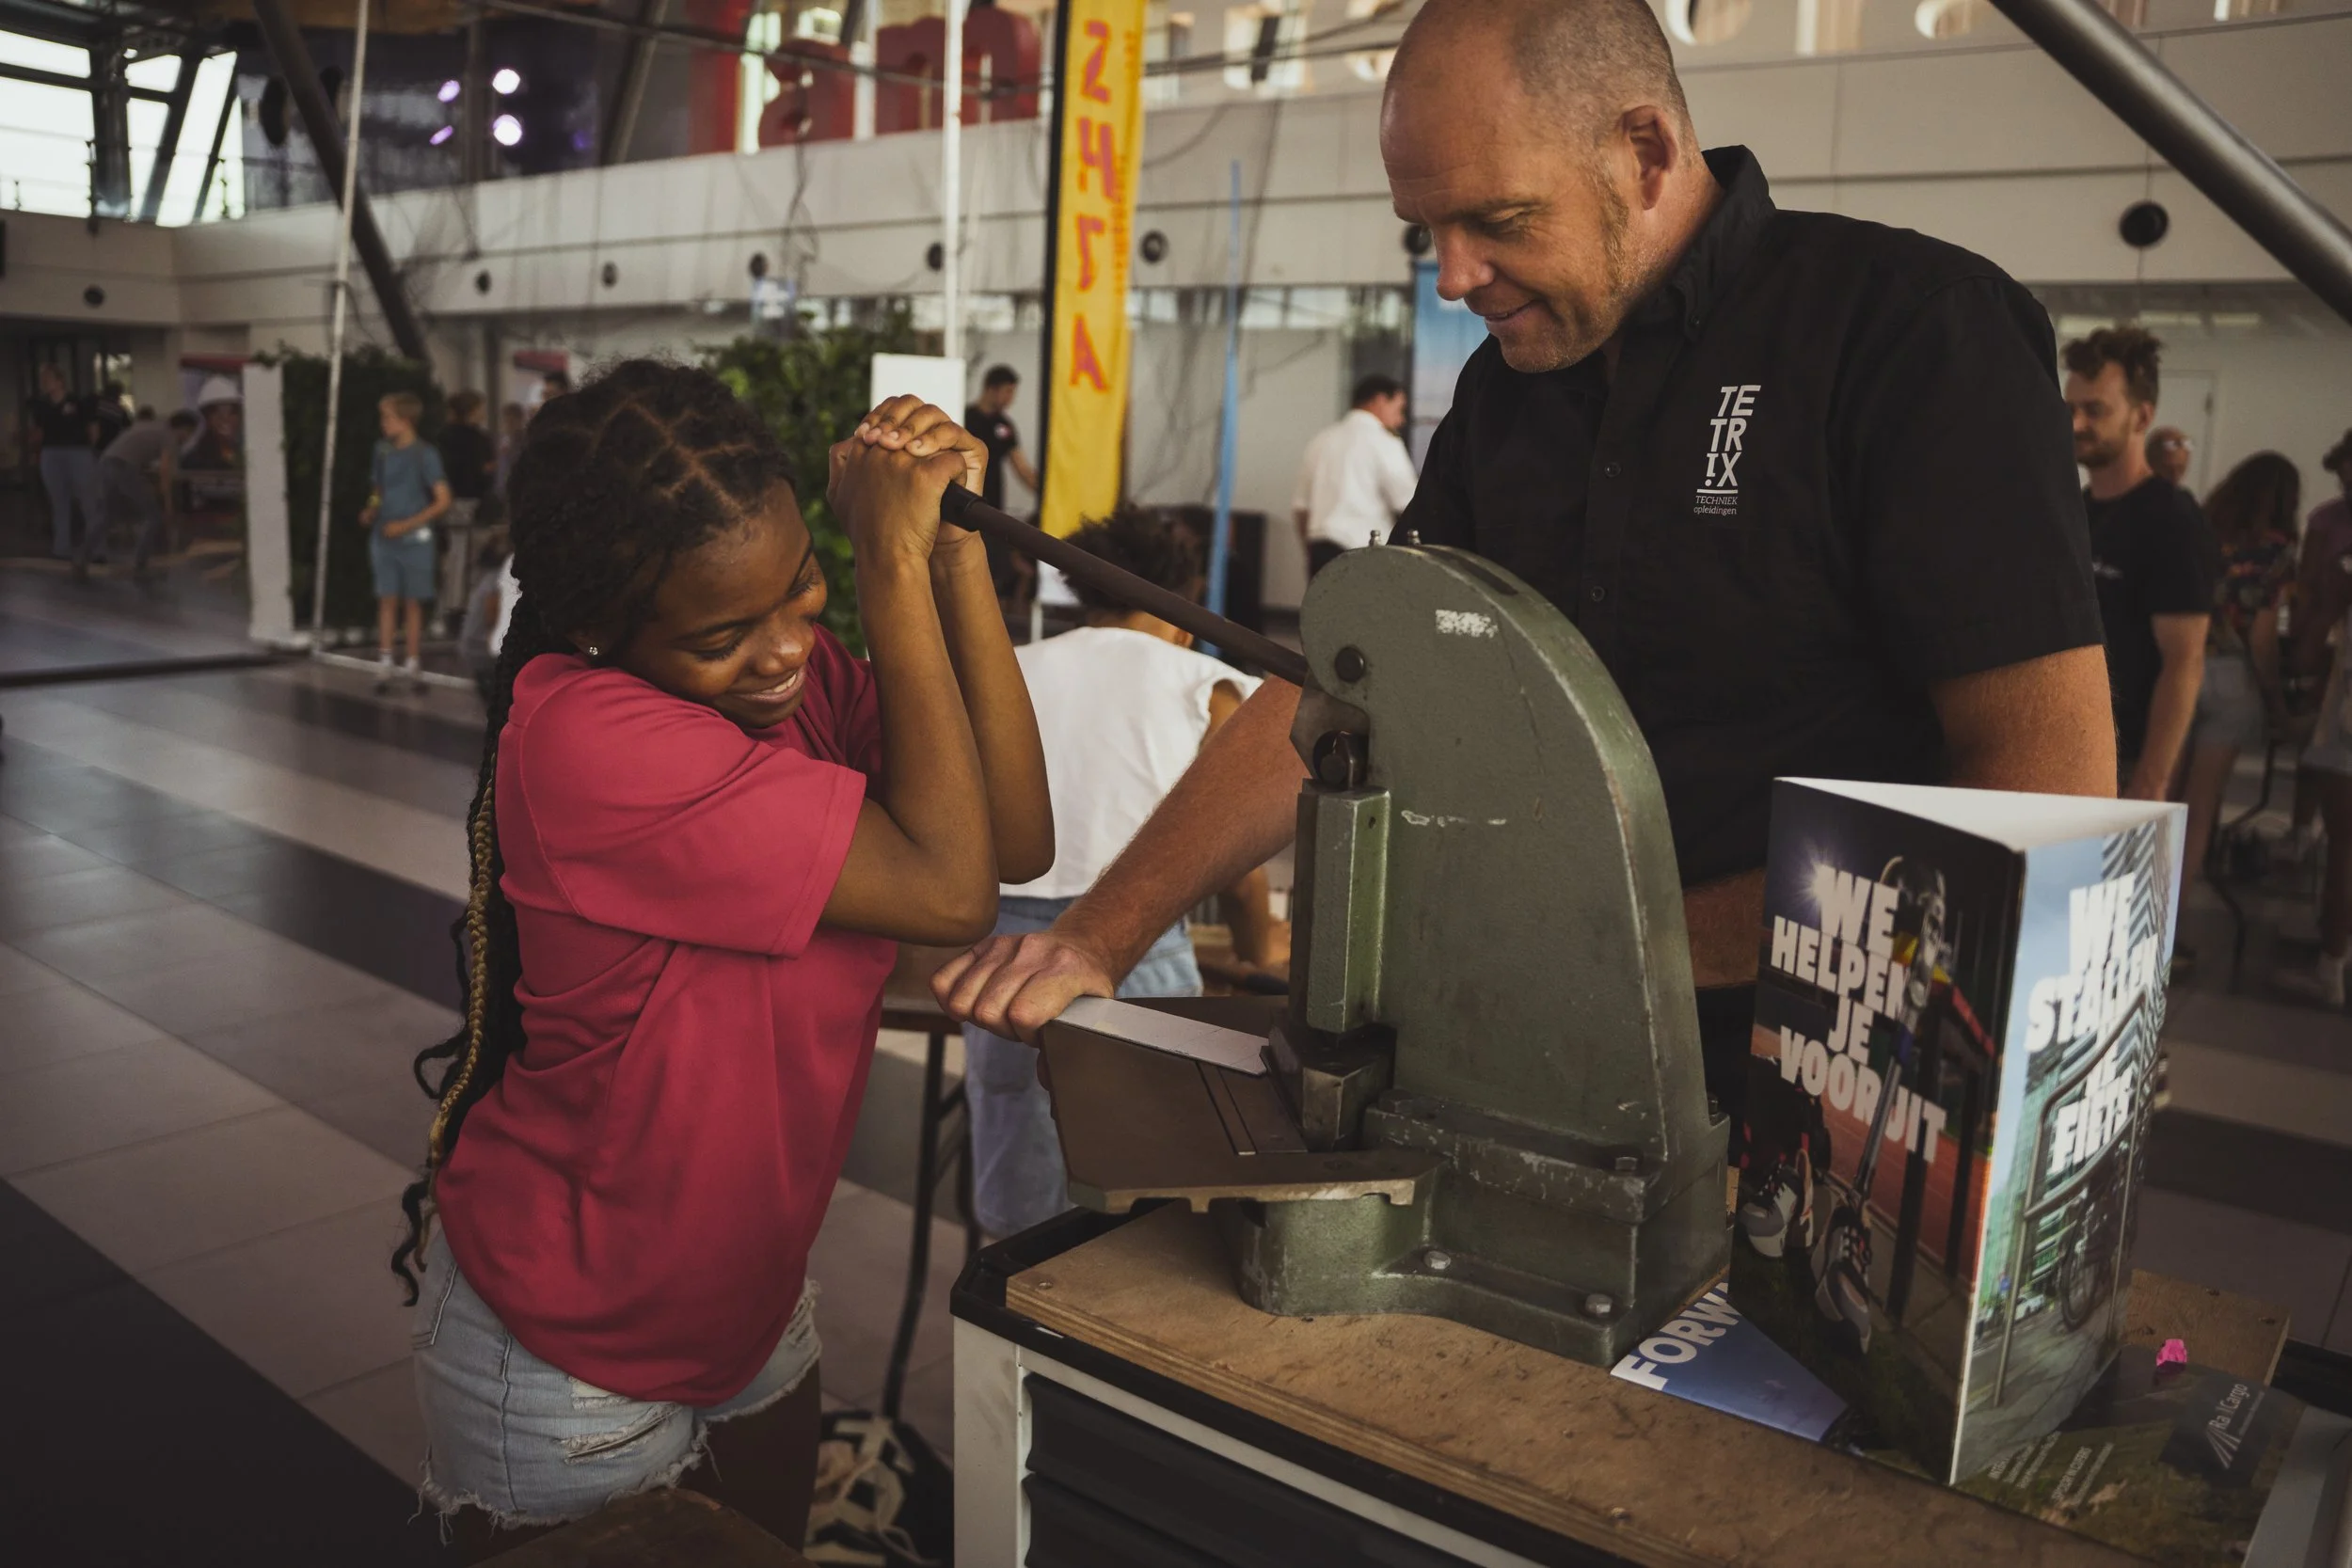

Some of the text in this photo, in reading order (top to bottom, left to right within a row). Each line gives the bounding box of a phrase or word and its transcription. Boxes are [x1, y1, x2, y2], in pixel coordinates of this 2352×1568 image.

[1693, 505, 1738, 516] opleidingen
[1695, 496, 1738, 505] TECHNIEK
[1815, 863, 1899, 958] WE
[2069, 872, 2135, 974] WE
[1771, 915, 1910, 1022] HELPEN
[1827, 997, 1874, 1066] JE
